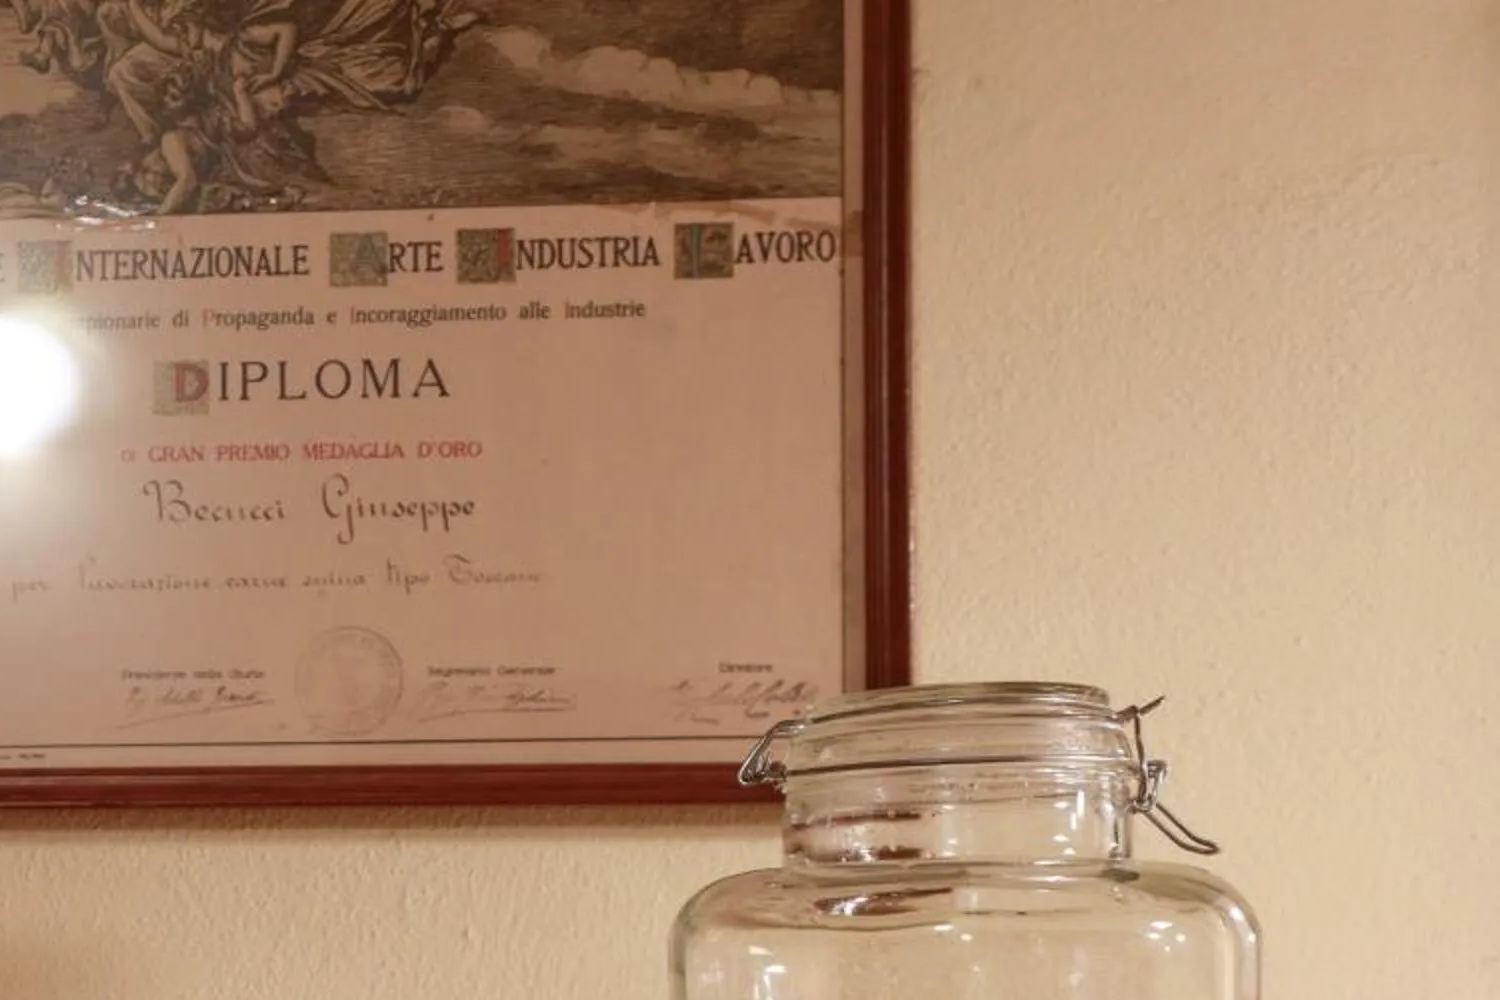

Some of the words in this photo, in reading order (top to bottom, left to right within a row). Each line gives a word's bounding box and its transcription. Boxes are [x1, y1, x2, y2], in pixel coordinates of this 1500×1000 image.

[54, 242, 310, 291] INTERNAZIONALE
[356, 234, 444, 274] ARTE
[494, 229, 661, 277] INDUSTRIA
[171, 309, 189, 329] di
[202, 307, 315, 331] Propaganda
[326, 311, 337, 324] e
[350, 304, 507, 328] Incoraggiamento
[519, 301, 550, 320] alle
[565, 299, 647, 320] Industrie
[173, 358, 451, 402] DIPLOMA
[148, 446, 204, 463] GRAN
[217, 445, 290, 462] PREMIO
[303, 443, 405, 461] MEDAGLIA
[417, 441, 483, 460] D'ORO
[321, 473, 476, 545] Giuseppe
